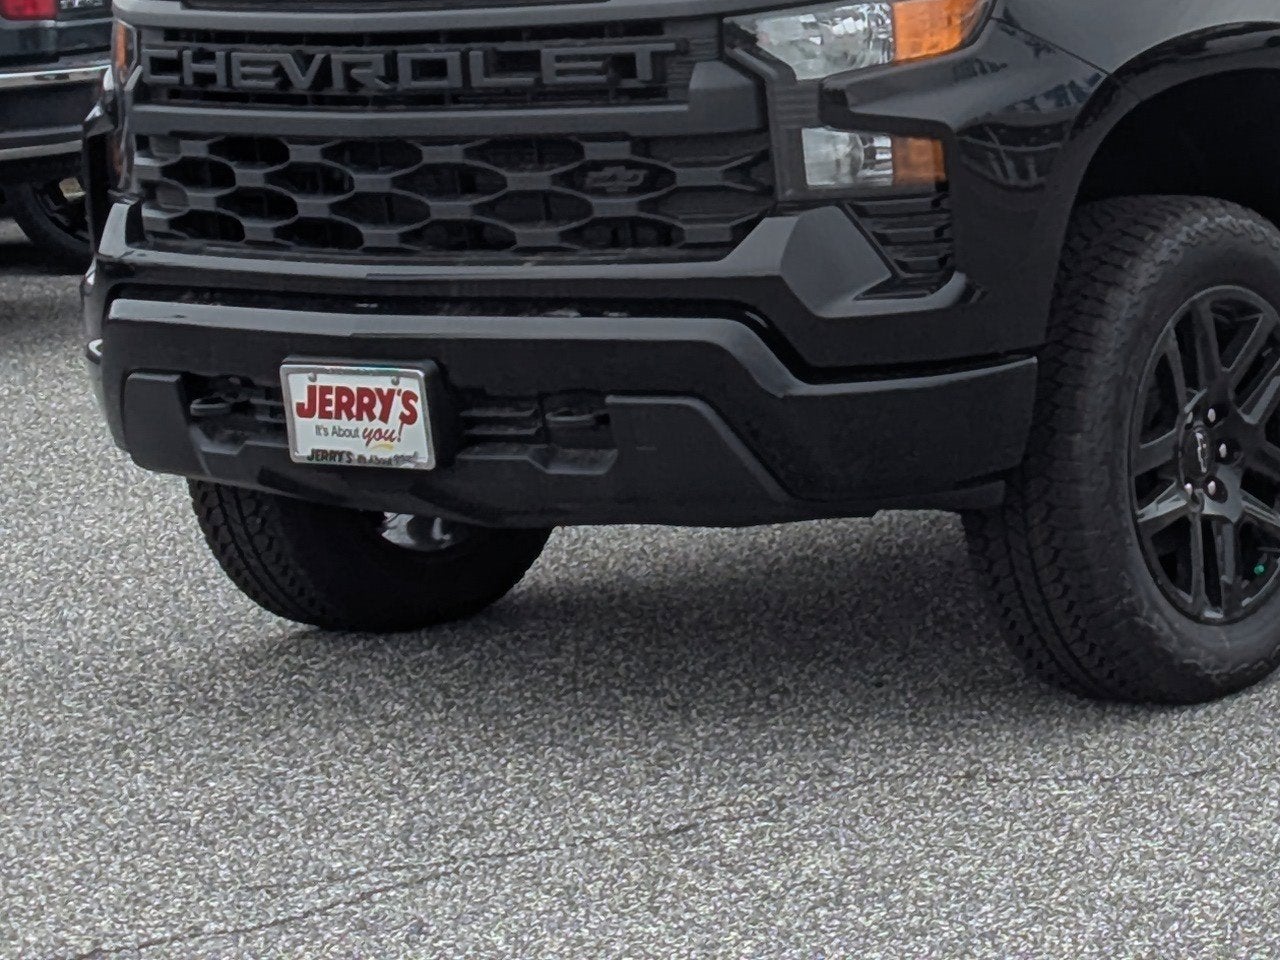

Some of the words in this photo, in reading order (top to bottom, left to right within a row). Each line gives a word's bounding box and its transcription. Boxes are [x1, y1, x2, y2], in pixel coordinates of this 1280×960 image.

[141, 42, 676, 90] CHEVROLET
[295, 384, 419, 426] JERRY'S
[315, 425, 329, 437] It's
[331, 426, 360, 438] About
[362, 424, 403, 448] you!
